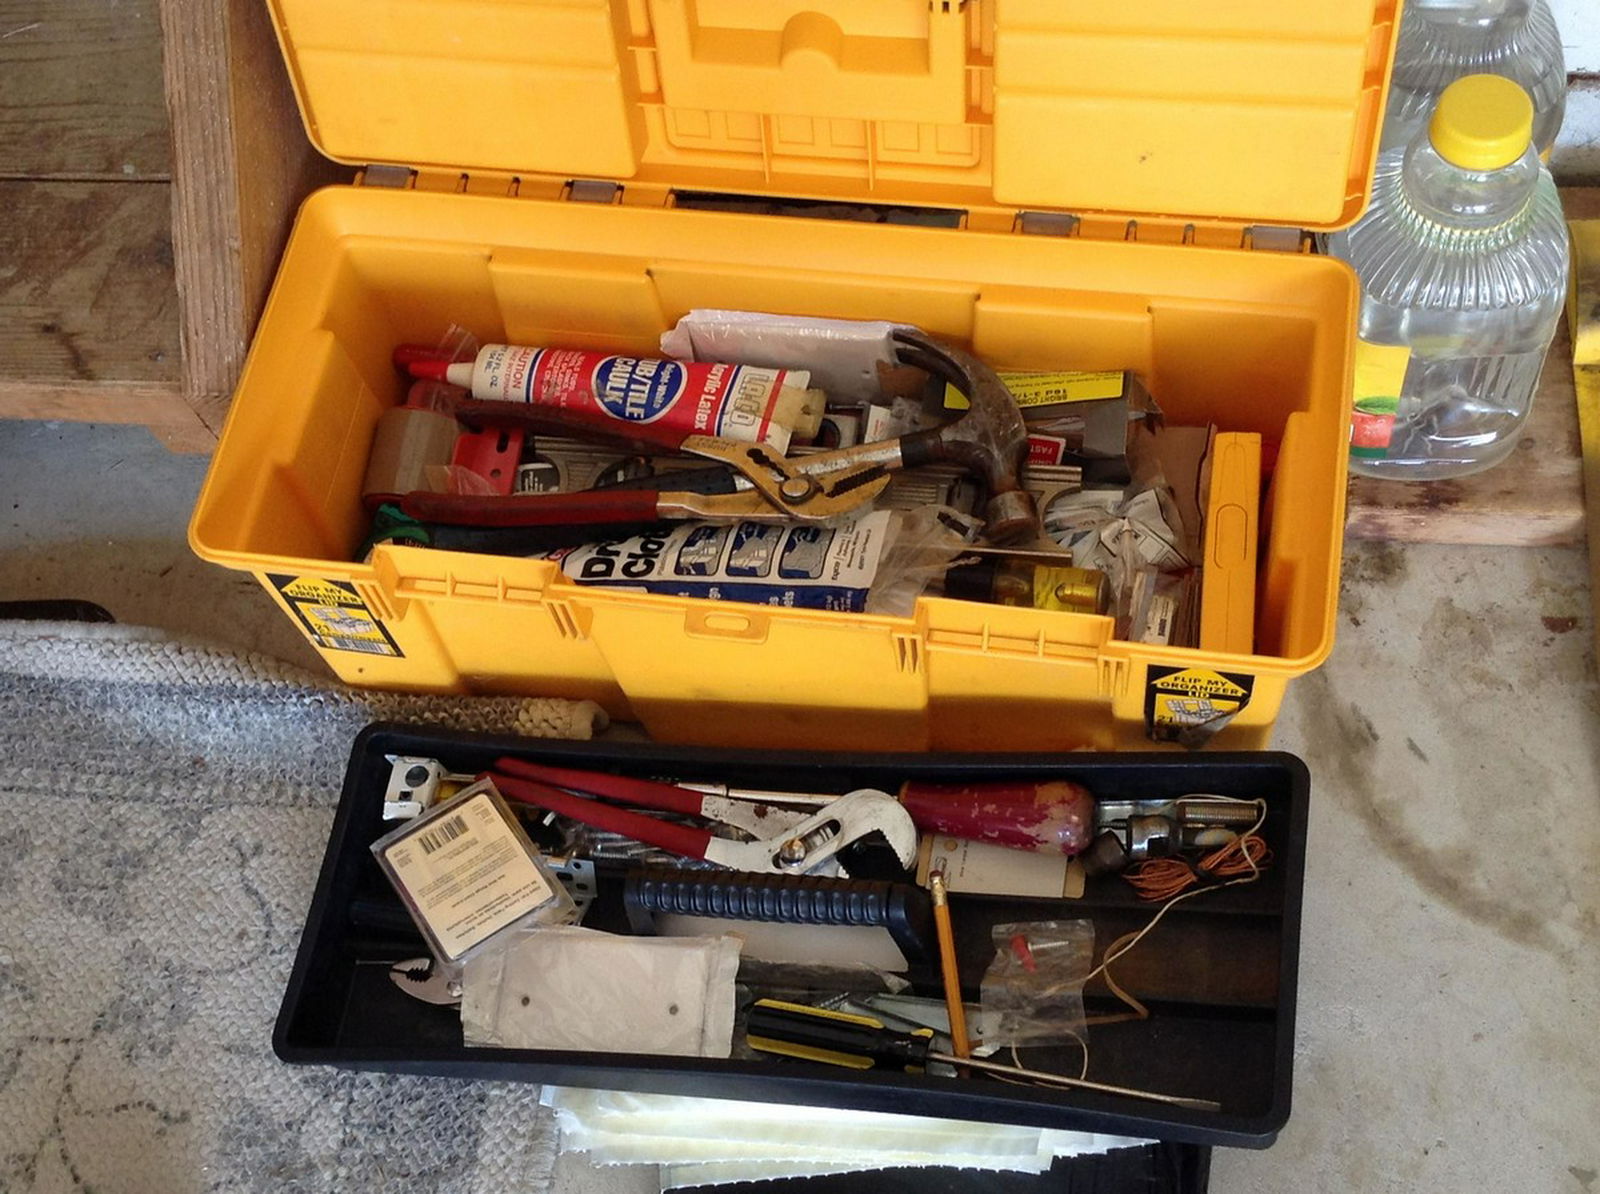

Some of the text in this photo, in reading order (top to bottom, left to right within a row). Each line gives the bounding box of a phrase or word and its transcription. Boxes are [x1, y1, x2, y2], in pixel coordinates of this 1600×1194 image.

[604, 358, 635, 404] CAULK
[626, 360, 659, 418] UB/TILE
[695, 394, 716, 430] Latex
[1160, 682, 1240, 694] ORGANIZER
